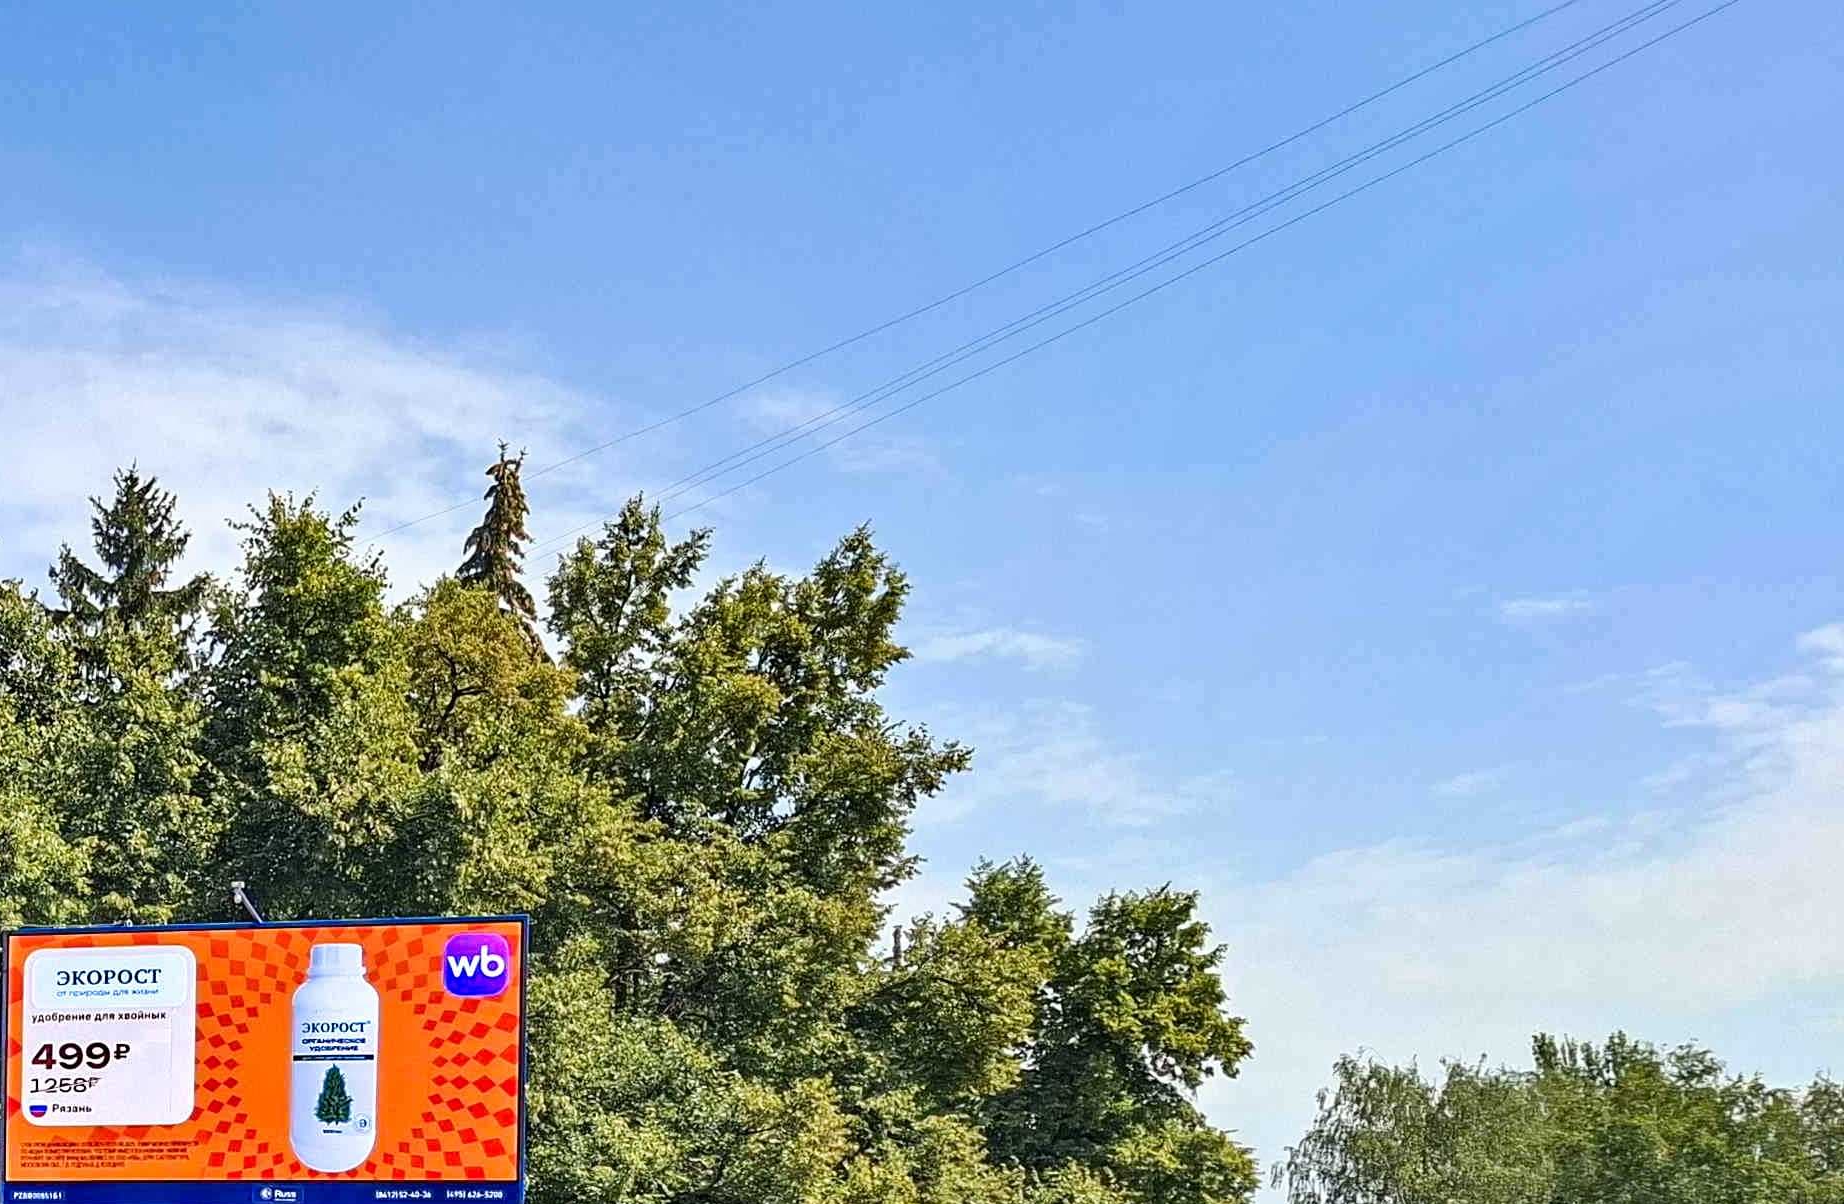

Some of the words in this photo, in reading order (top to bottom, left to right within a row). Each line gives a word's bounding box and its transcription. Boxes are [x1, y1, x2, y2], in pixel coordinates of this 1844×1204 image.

[447, 945, 505, 978] wb
[56, 968, 162, 986] ЭКОРОСТ
[31, 1011, 92, 1024] удобрение
[94, 1012, 116, 1022] для
[301, 1021, 366, 1033] ЭКОРОСТ
[51, 1103, 93, 1113] Рязань
